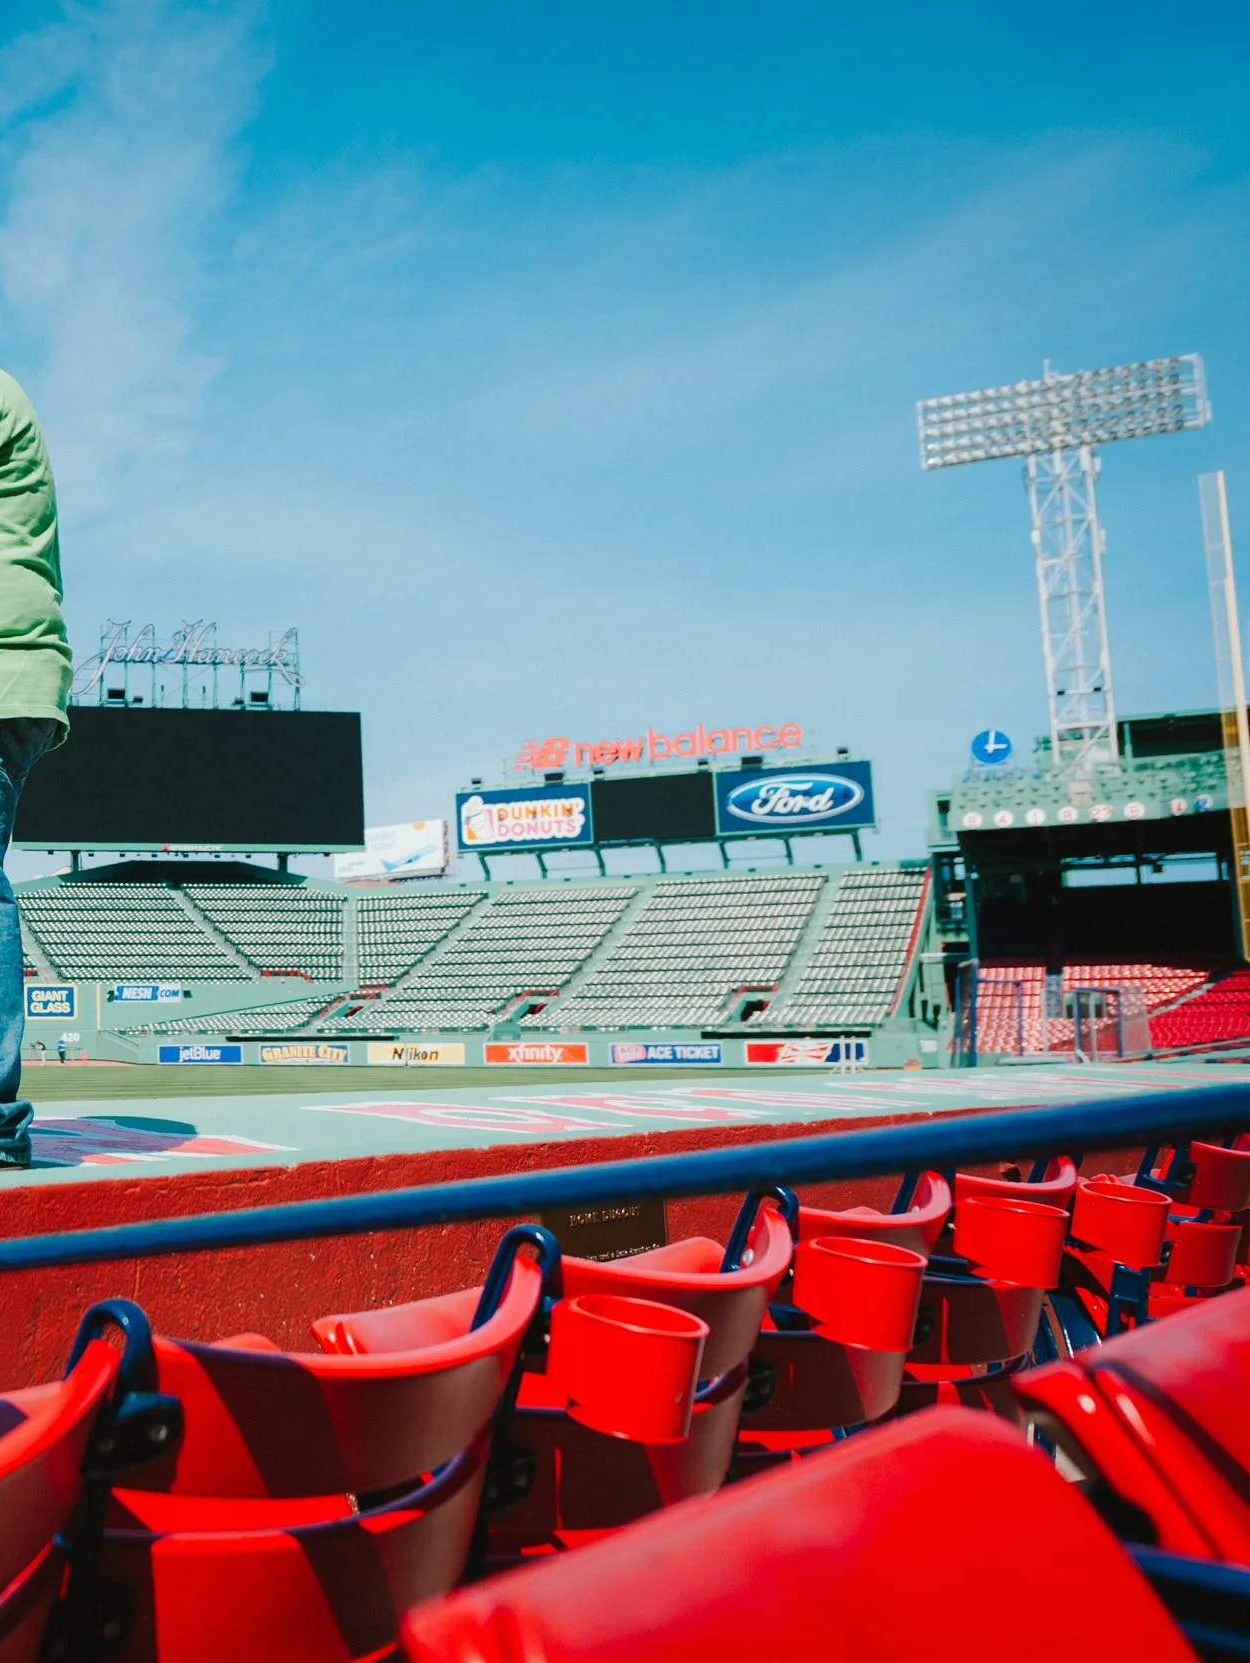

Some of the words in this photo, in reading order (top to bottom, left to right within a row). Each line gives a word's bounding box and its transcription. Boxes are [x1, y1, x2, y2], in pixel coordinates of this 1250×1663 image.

[70, 619, 161, 696] John
[161, 619, 306, 688] Hancock
[574, 737, 644, 767] new
[647, 723, 803, 760] balance
[751, 782, 835, 815] Ford
[497, 819, 577, 837] DONUTS
[32, 990, 68, 1001] GIANT
[30, 1002, 70, 1014] GLASS
[61, 1033, 80, 1042] 420
[178, 1046, 221, 1062] jetBlue
[261, 1046, 316, 1061] GRANITE
[317, 1045, 347, 1061] CITY
[392, 1047, 439, 1061] Nikon
[508, 1045, 562, 1063] xfinity
[647, 1047, 673, 1059] ACE
[676, 1046, 719, 1059] TICKET
